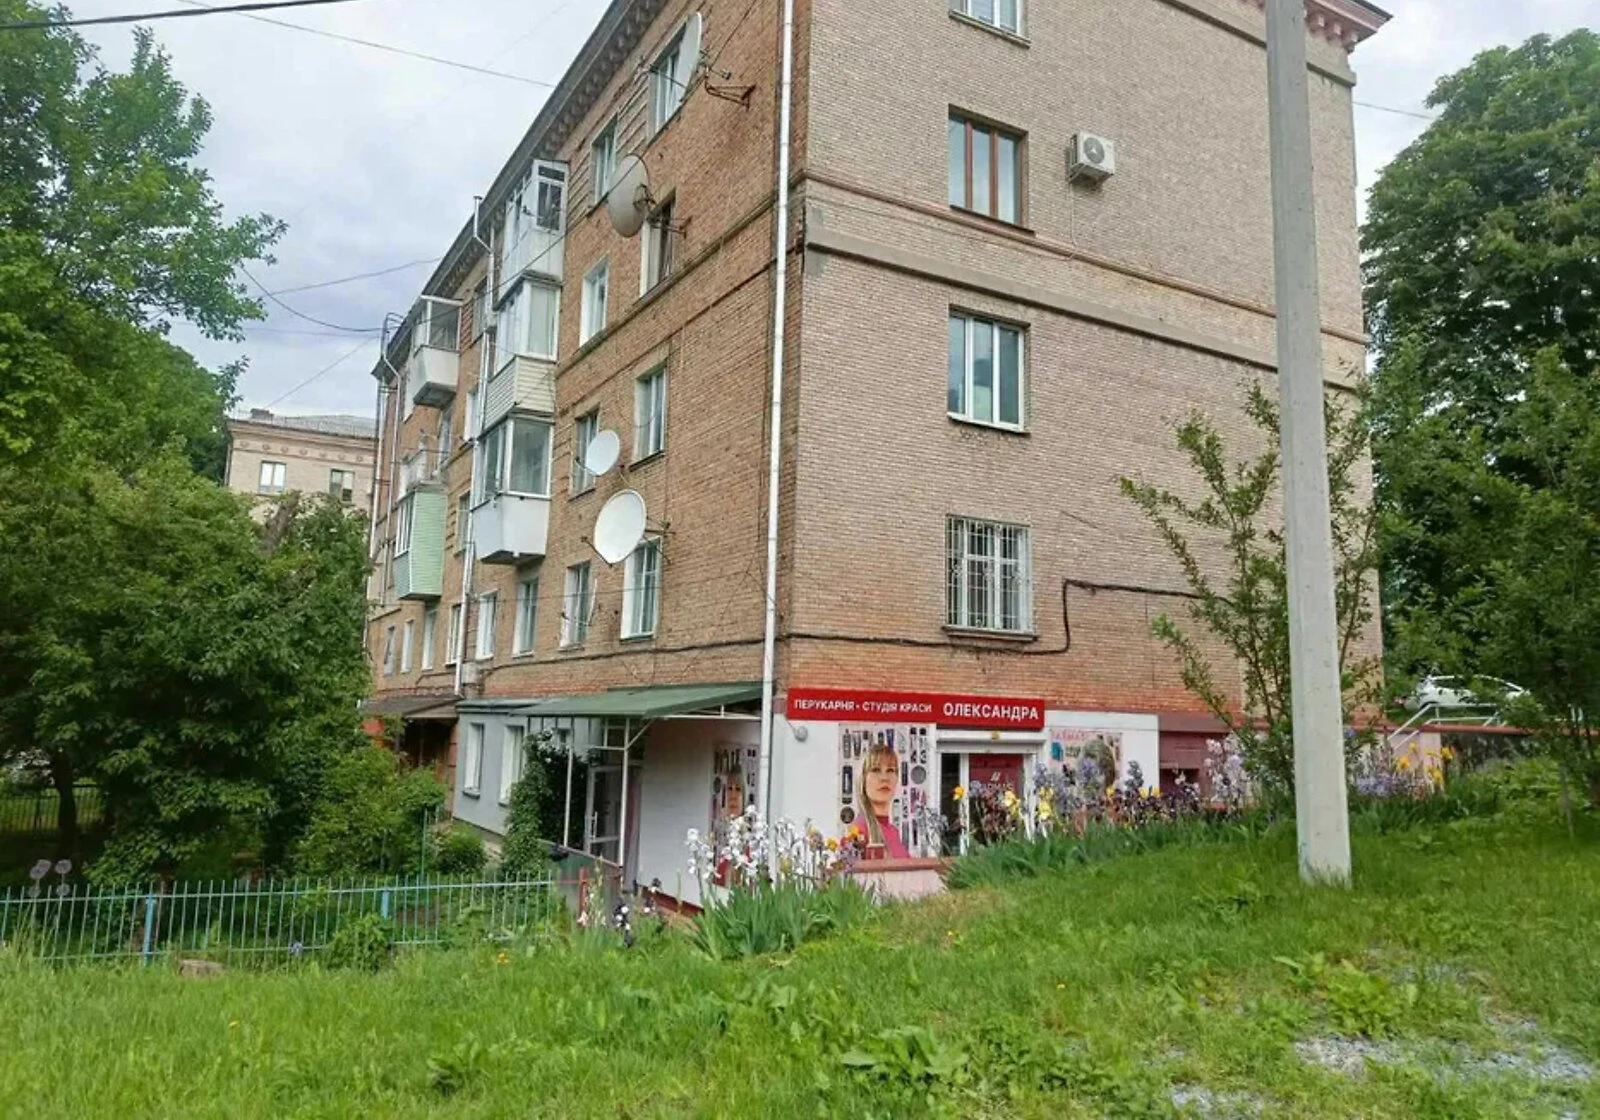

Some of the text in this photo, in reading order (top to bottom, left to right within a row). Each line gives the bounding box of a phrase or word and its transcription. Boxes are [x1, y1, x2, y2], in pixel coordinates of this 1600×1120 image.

[794, 699, 855, 710] ПЕРУКАРНЯ
[862, 701, 898, 713] СТУДІЯ
[900, 702, 932, 713] КРАСИ
[943, 702, 1039, 722] ОЛЕКСАНДРА
